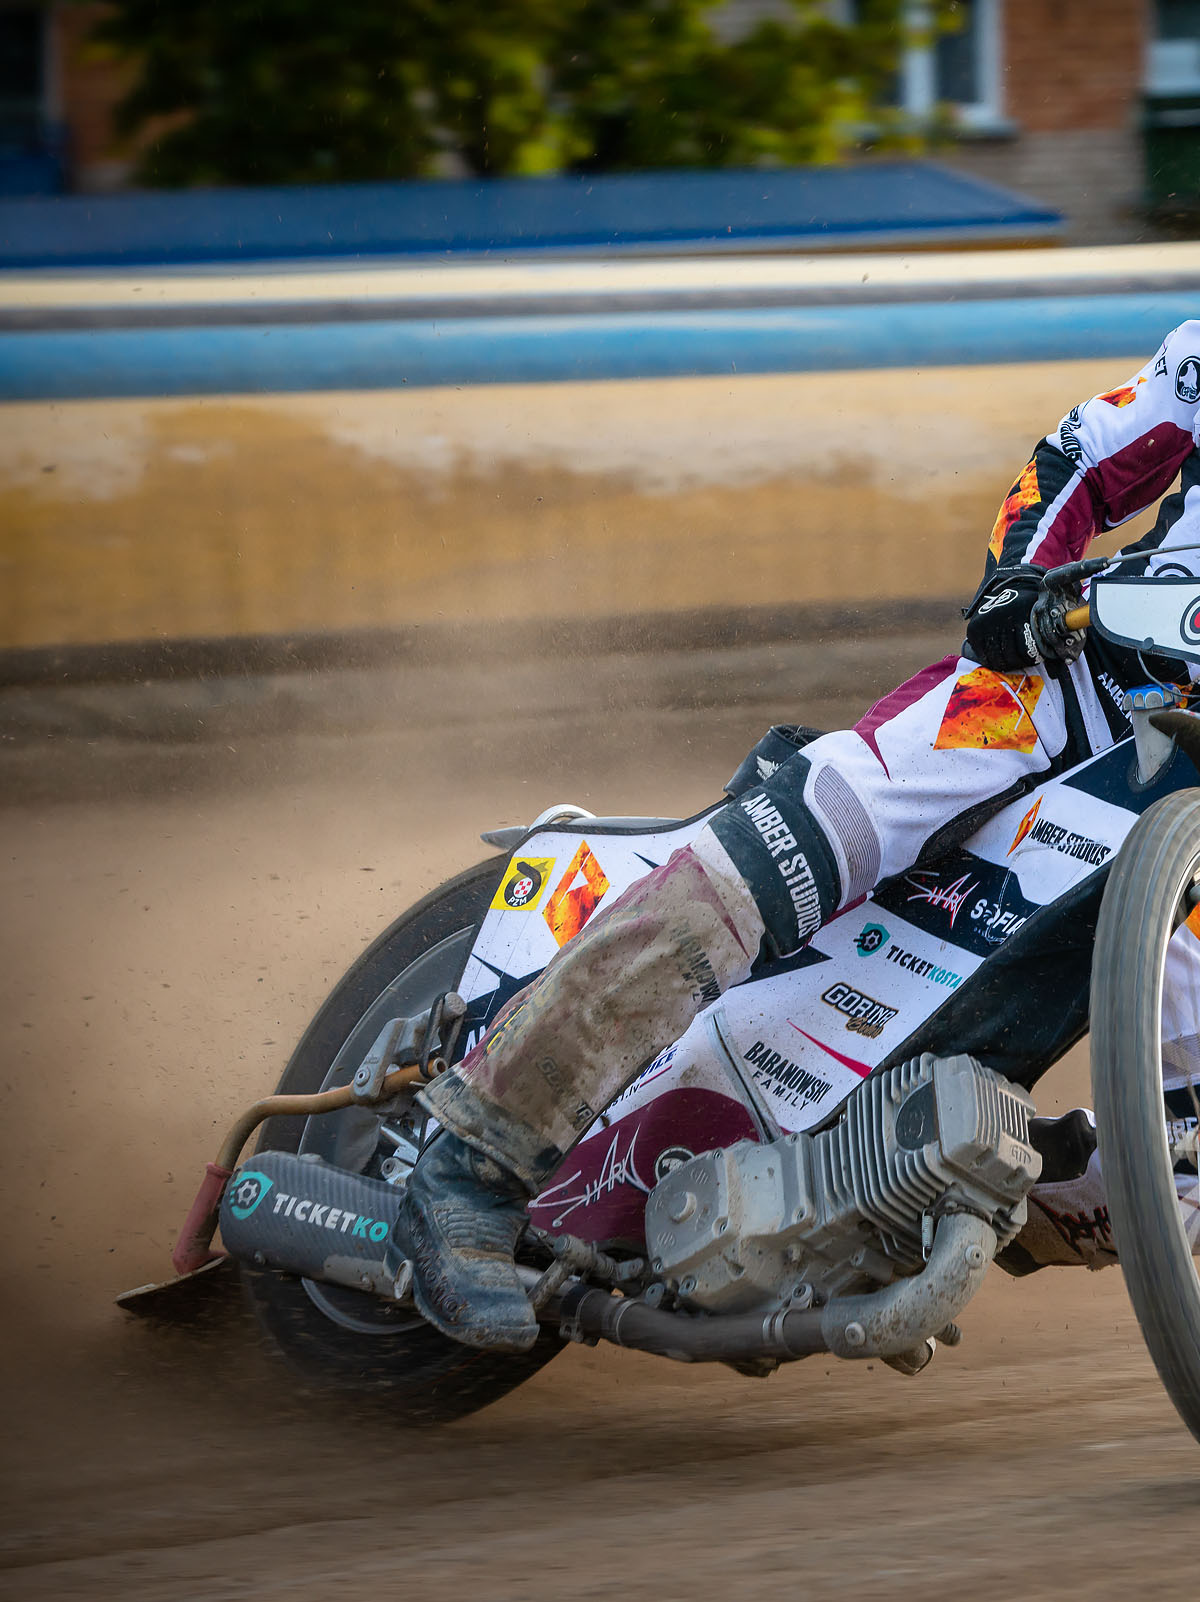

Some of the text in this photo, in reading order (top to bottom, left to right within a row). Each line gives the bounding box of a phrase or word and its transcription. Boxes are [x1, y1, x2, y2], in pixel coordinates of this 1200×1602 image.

[740, 792, 822, 940] AMBER STUDIOS
[1028, 817, 1112, 867] AMBER STUDIOS
[507, 896, 528, 907] PZM
[885, 944, 963, 990] TICKETKOSTA
[752, 1070, 810, 1111] FAMILY
[272, 1192, 389, 1244] TICKETKO
